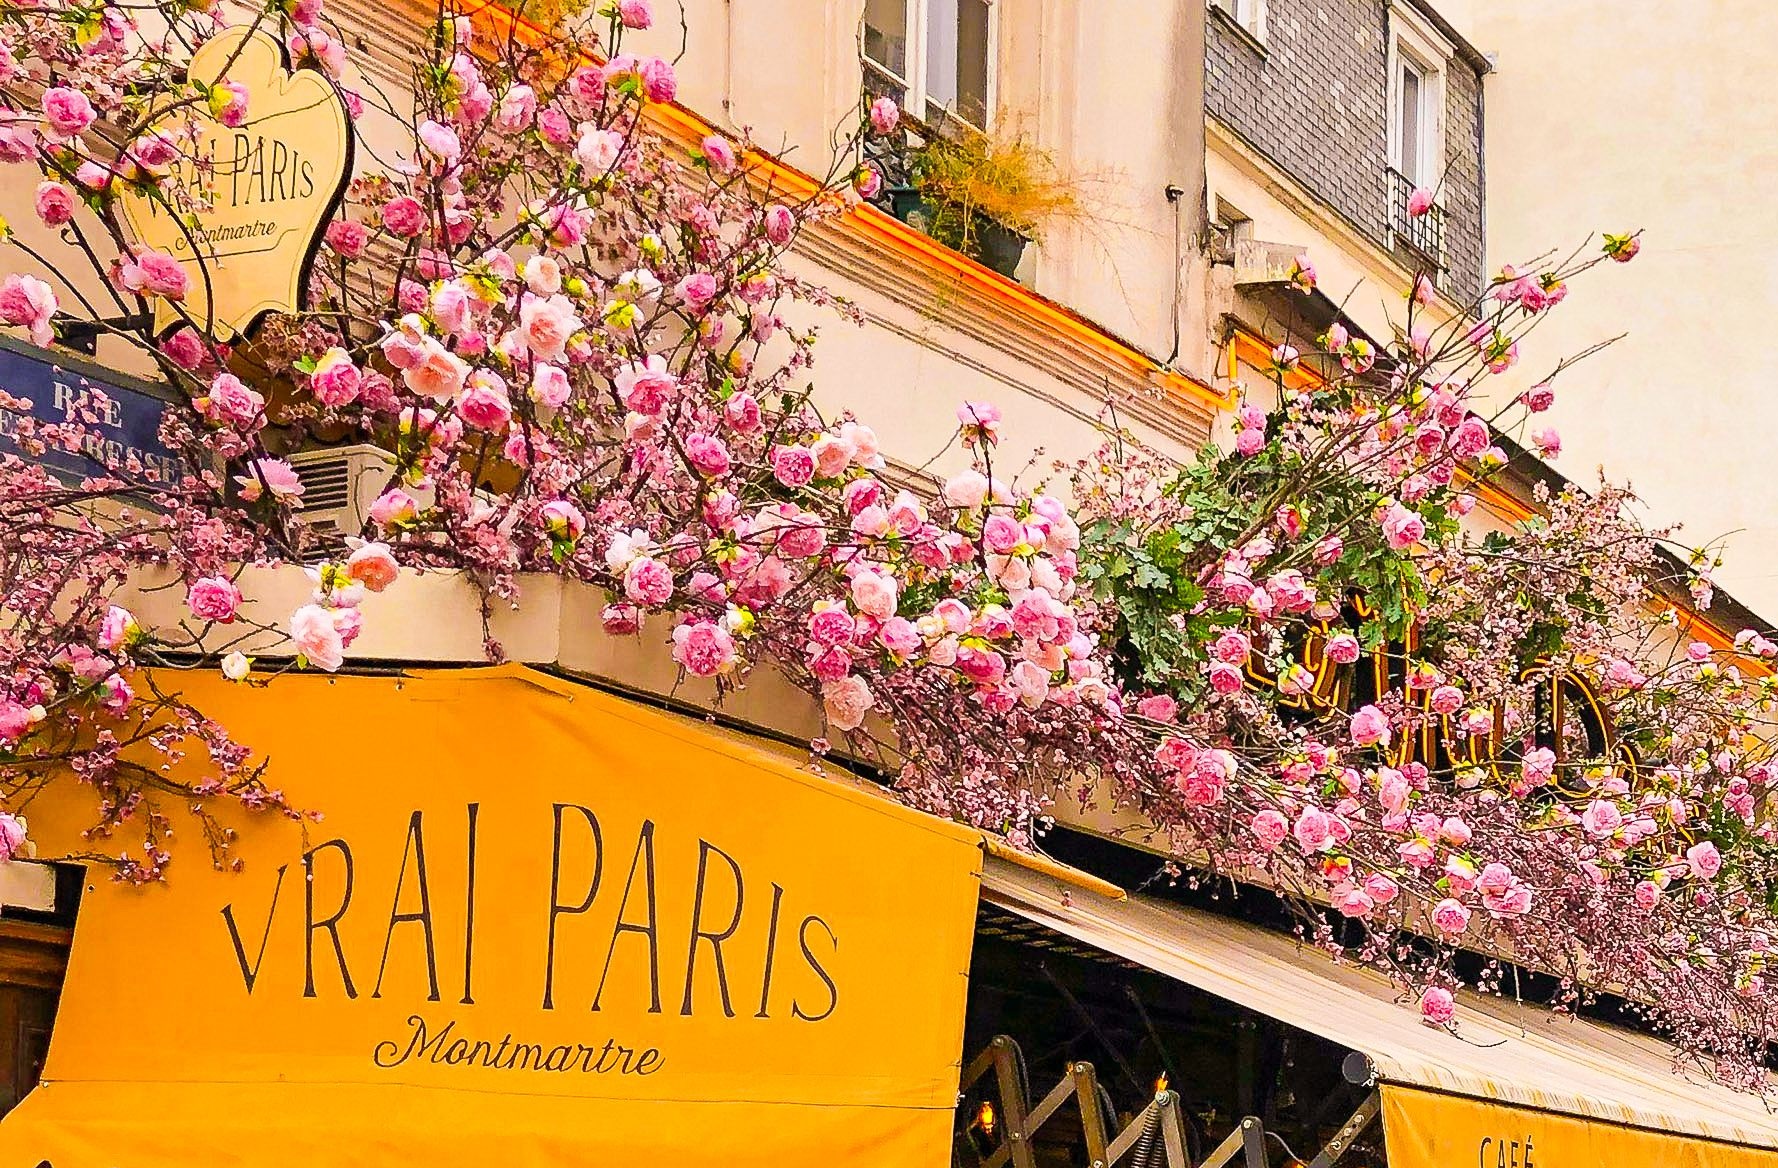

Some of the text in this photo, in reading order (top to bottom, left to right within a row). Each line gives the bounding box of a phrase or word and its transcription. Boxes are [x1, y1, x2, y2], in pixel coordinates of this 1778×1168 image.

[147, 133, 314, 218] RAI PARIS
[53, 381, 122, 428] RE
[220, 802, 839, 1023] VRAI PARIS
[373, 1014, 666, 1076] Montmartre
